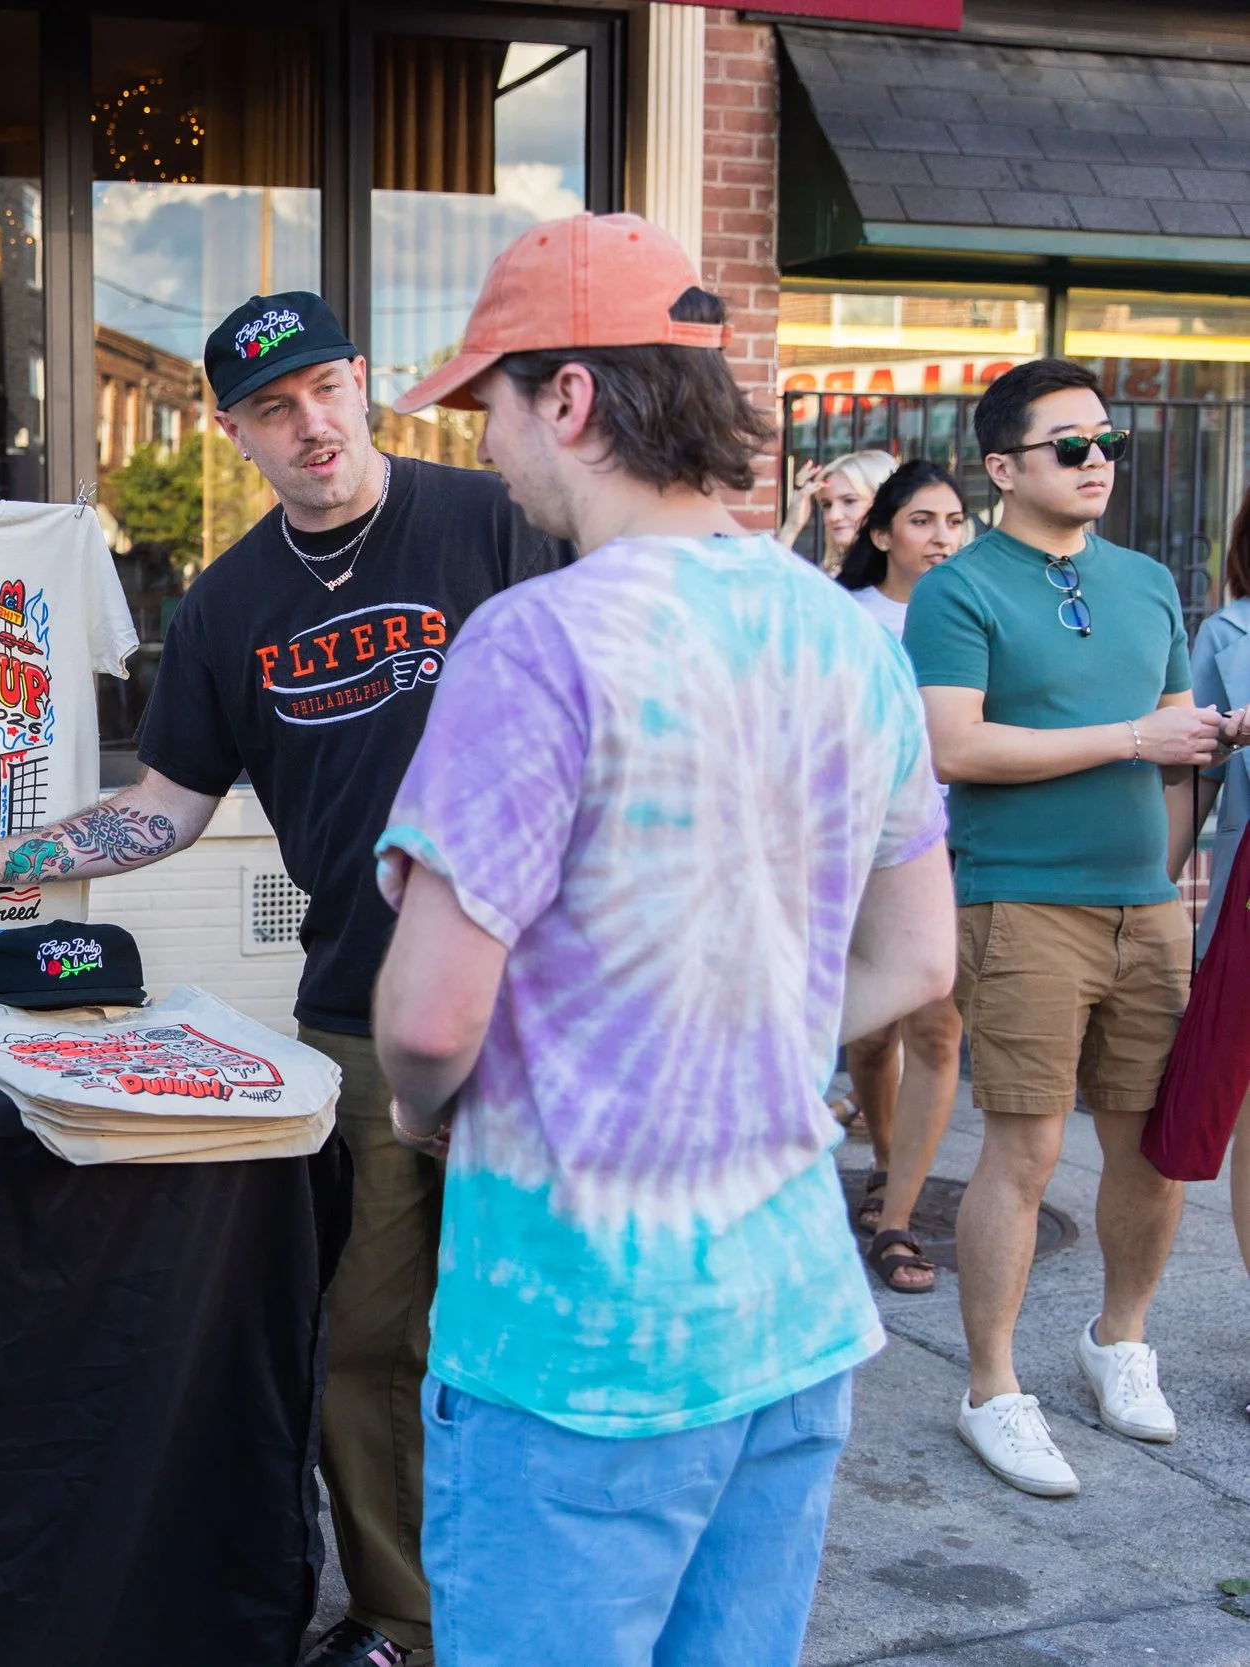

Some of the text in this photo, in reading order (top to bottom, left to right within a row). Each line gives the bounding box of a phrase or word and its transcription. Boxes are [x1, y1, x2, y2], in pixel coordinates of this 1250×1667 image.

[236, 310, 299, 343] Cry Baby
[256, 611, 446, 689] FLYERS
[291, 678, 390, 717] PHILADELPHIA
[39, 938, 102, 961] Cry Baby
